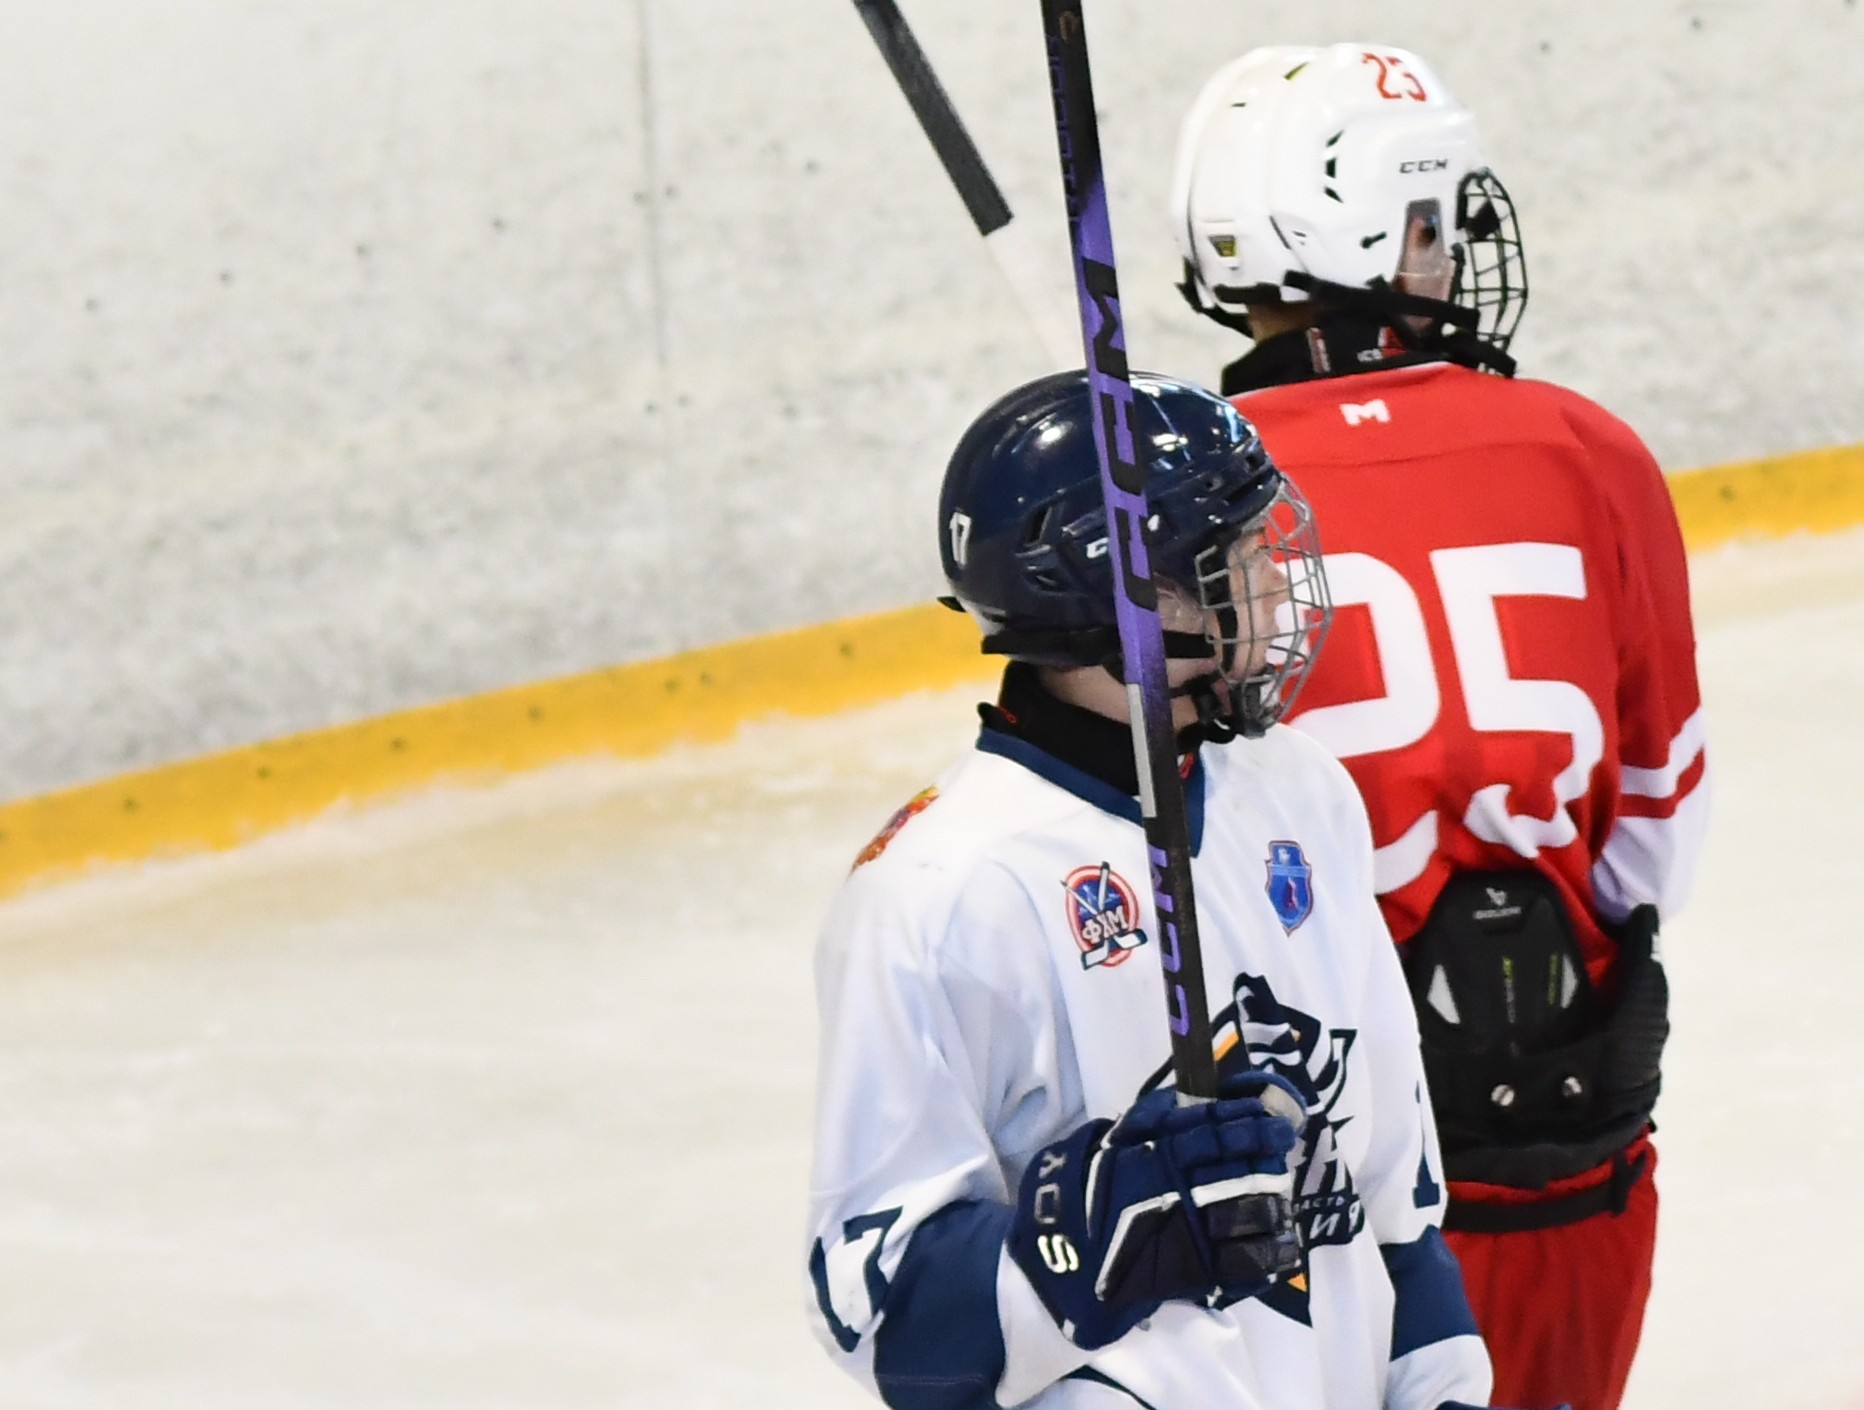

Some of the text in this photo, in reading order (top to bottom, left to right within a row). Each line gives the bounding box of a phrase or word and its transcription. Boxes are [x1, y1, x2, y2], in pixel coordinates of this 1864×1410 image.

[1400, 159, 1448, 174] CCM
[1082, 257, 1158, 612] CCM
[1263, 542, 1604, 895] 25
[1082, 905, 1130, 944] ФХМ
